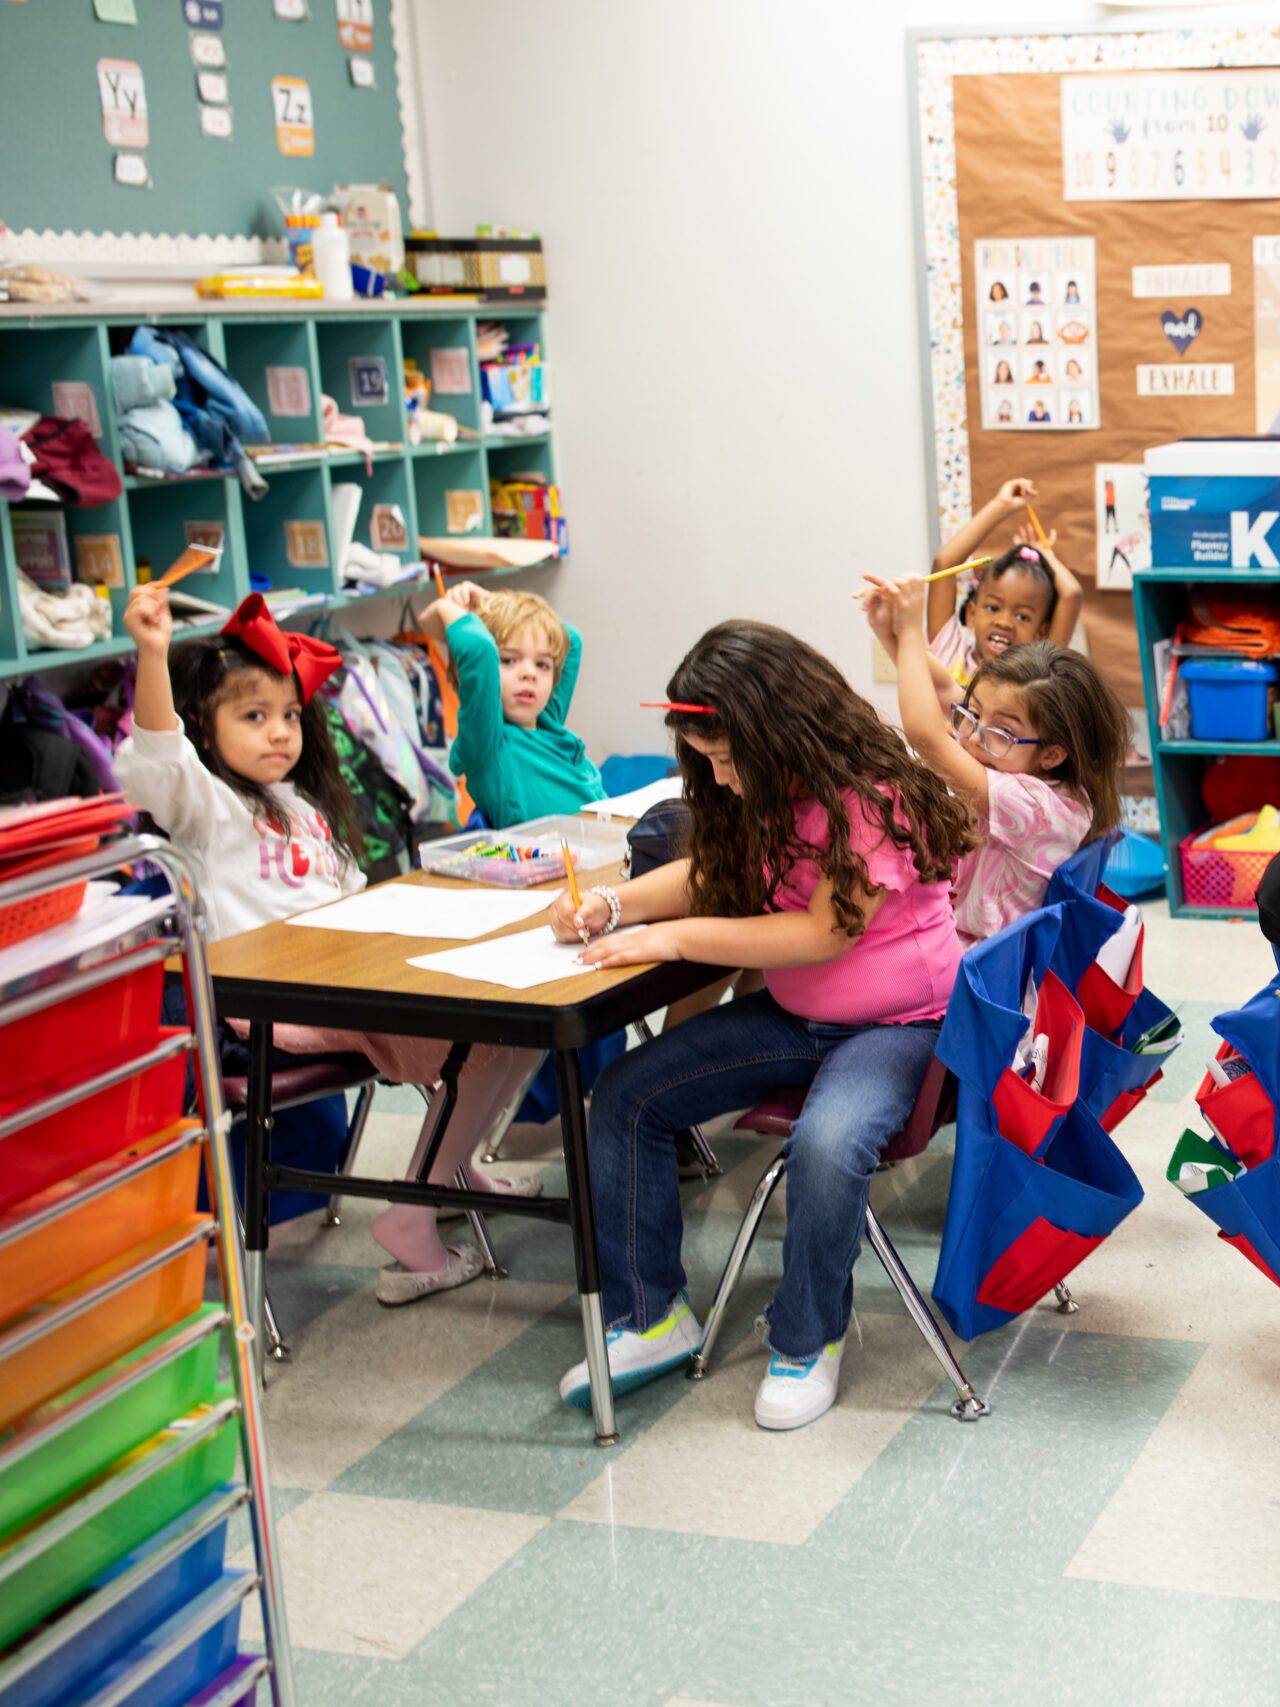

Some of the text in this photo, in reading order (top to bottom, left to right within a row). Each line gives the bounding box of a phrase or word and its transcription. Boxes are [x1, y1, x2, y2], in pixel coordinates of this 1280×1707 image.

[105, 71, 137, 120] Yy
[279, 88, 308, 124] Zz
[1072, 87, 1208, 115] COUNTING
[1207, 114, 1230, 132] 10
[1073, 151, 1094, 188] 10
[1106, 150, 1117, 188] 9
[1128, 149, 1139, 187] 8
[1173, 148, 1185, 186] 6
[1198, 147, 1209, 187] 5
[1219, 147, 1232, 185] 4
[1244, 146, 1255, 185] 3
[1268, 145, 1279, 185] 2
[1145, 269, 1217, 292] INHALE
[1163, 311, 1200, 339] and
[359, 371, 382, 393] 19
[1148, 368, 1221, 392] EXHALE
[380, 517, 402, 540] 20
[1230, 510, 1280, 568] K
[1190, 539, 1229, 552] Fluency
[1193, 551, 1229, 561] Builder
[88, 552, 112, 575] 14
